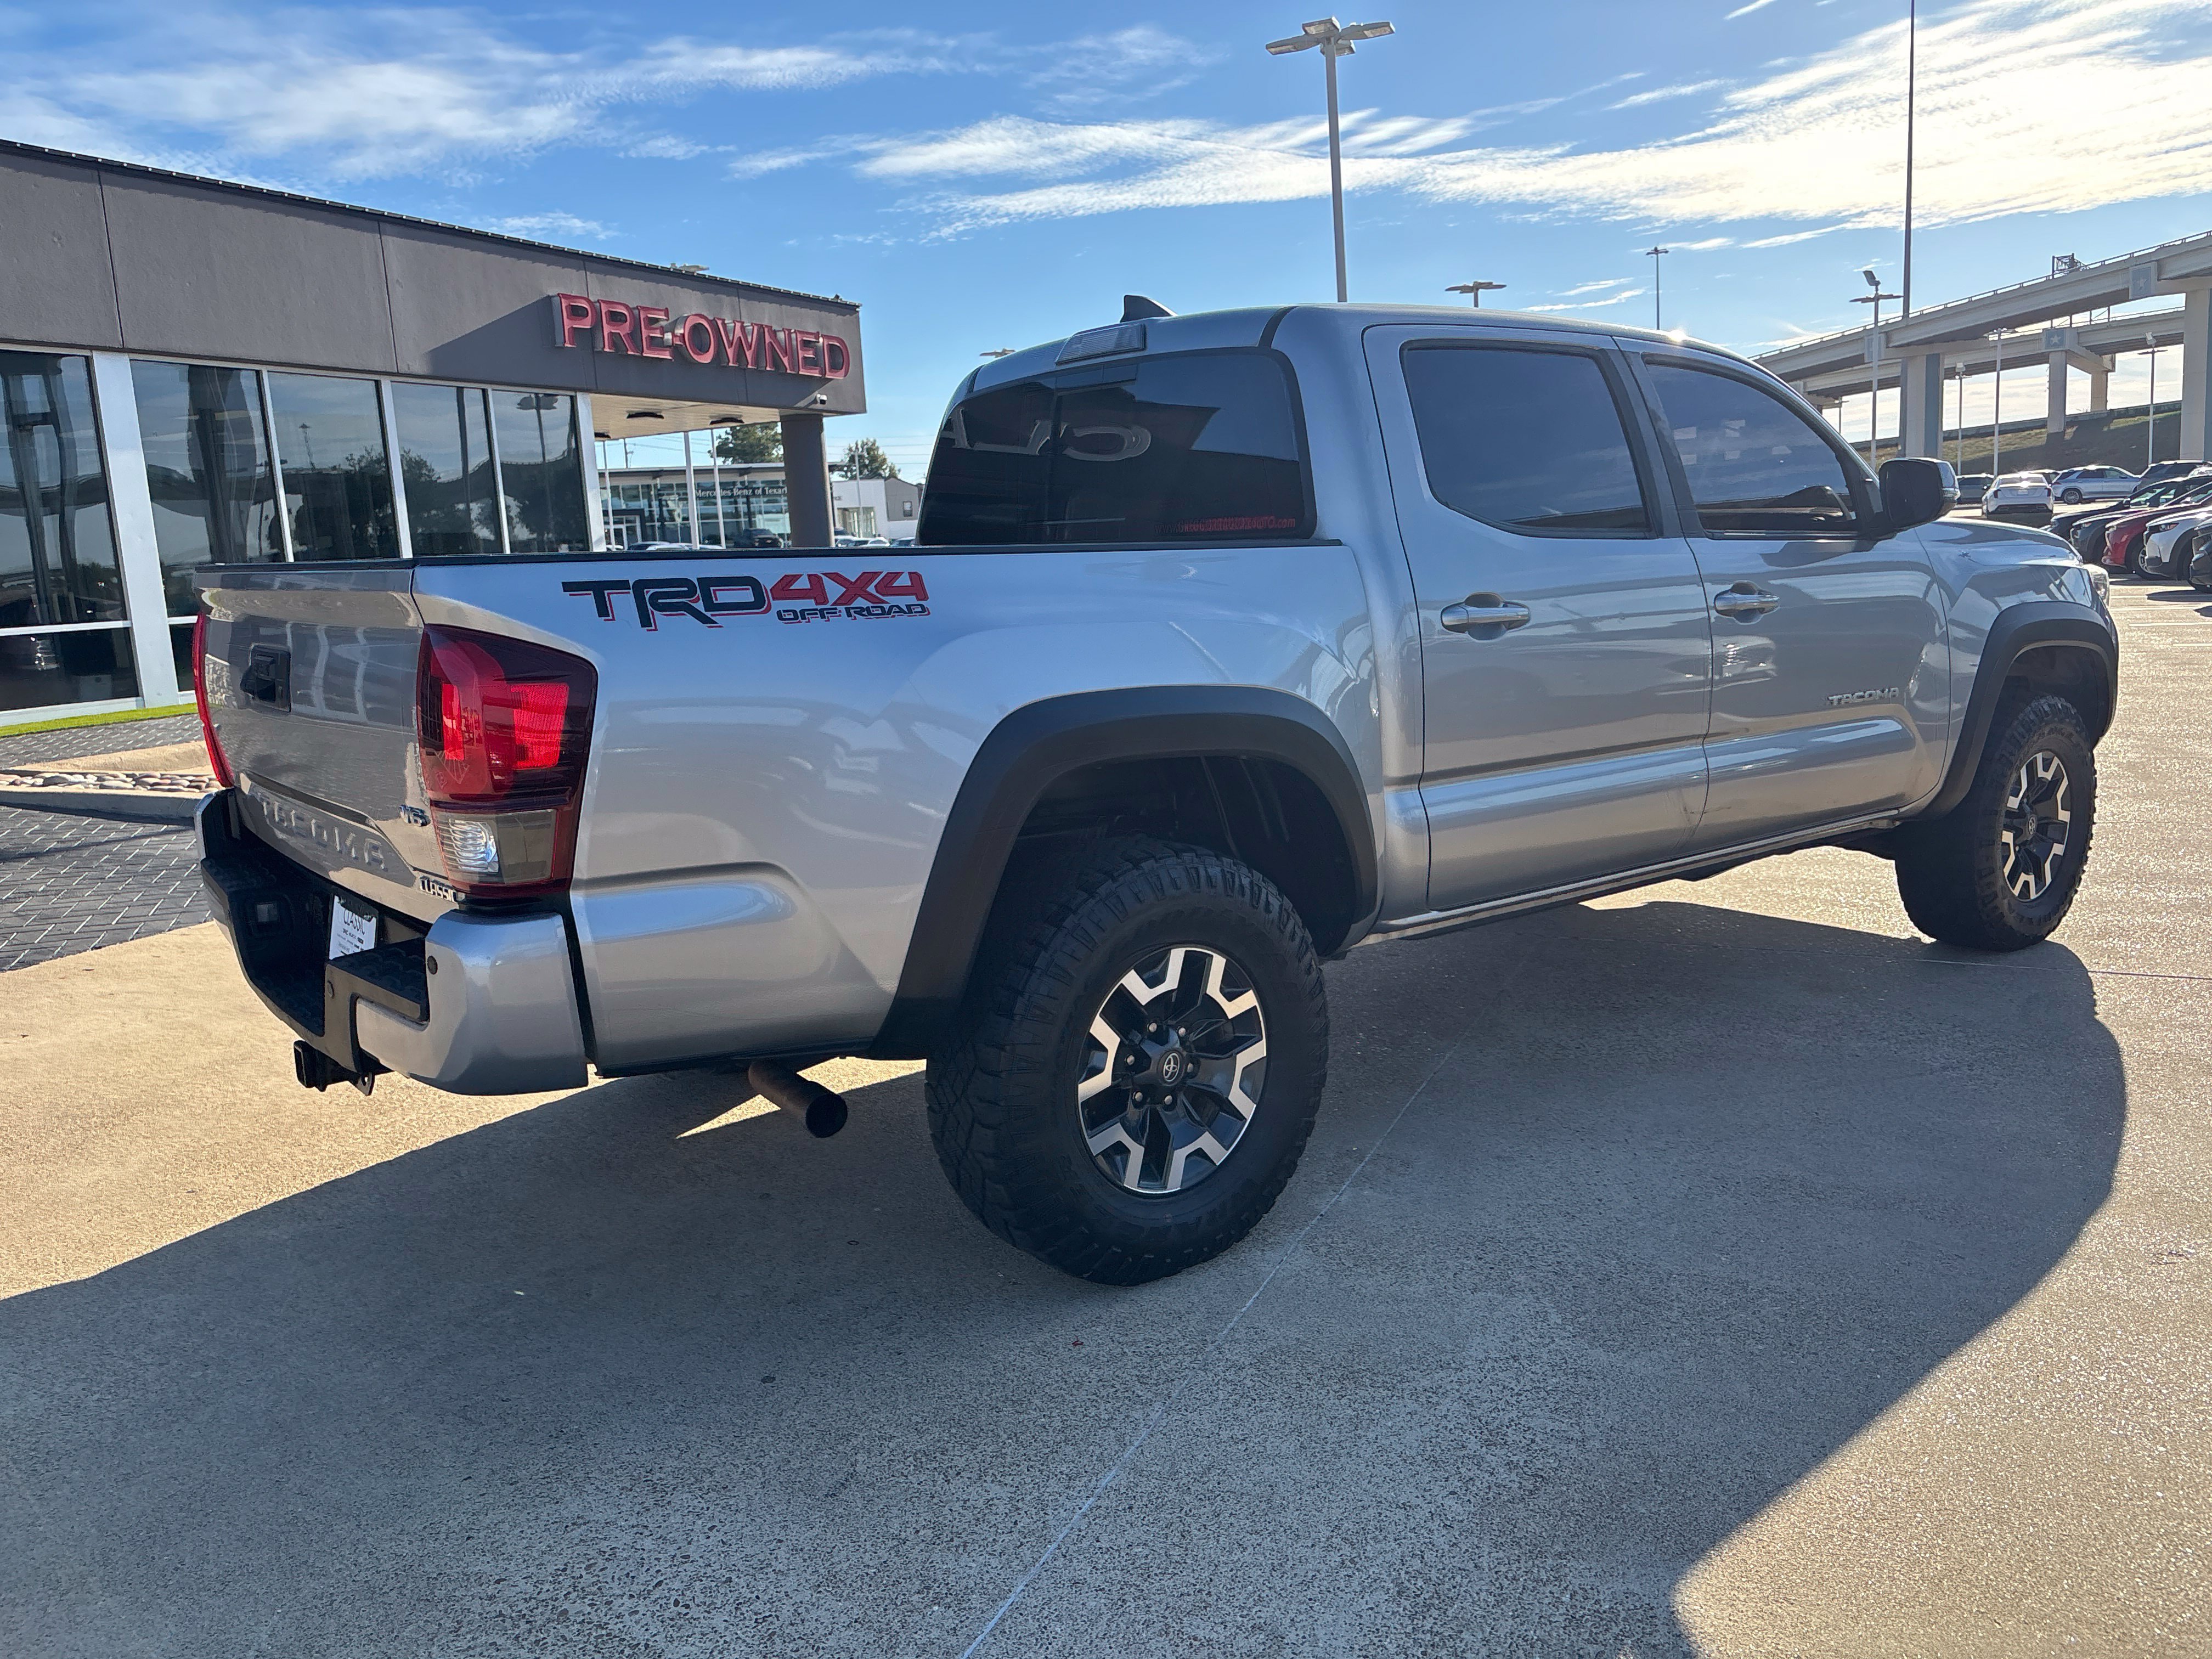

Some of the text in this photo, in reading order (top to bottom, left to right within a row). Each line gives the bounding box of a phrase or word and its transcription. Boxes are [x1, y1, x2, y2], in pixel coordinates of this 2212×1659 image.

[556, 293, 850, 379] PRE-OWNED
[562, 575, 772, 632] TRD
[776, 603, 931, 624] OFF ROAD
[1827, 687, 1900, 705] TACOMA
[420, 877, 457, 903] CLASSIC
